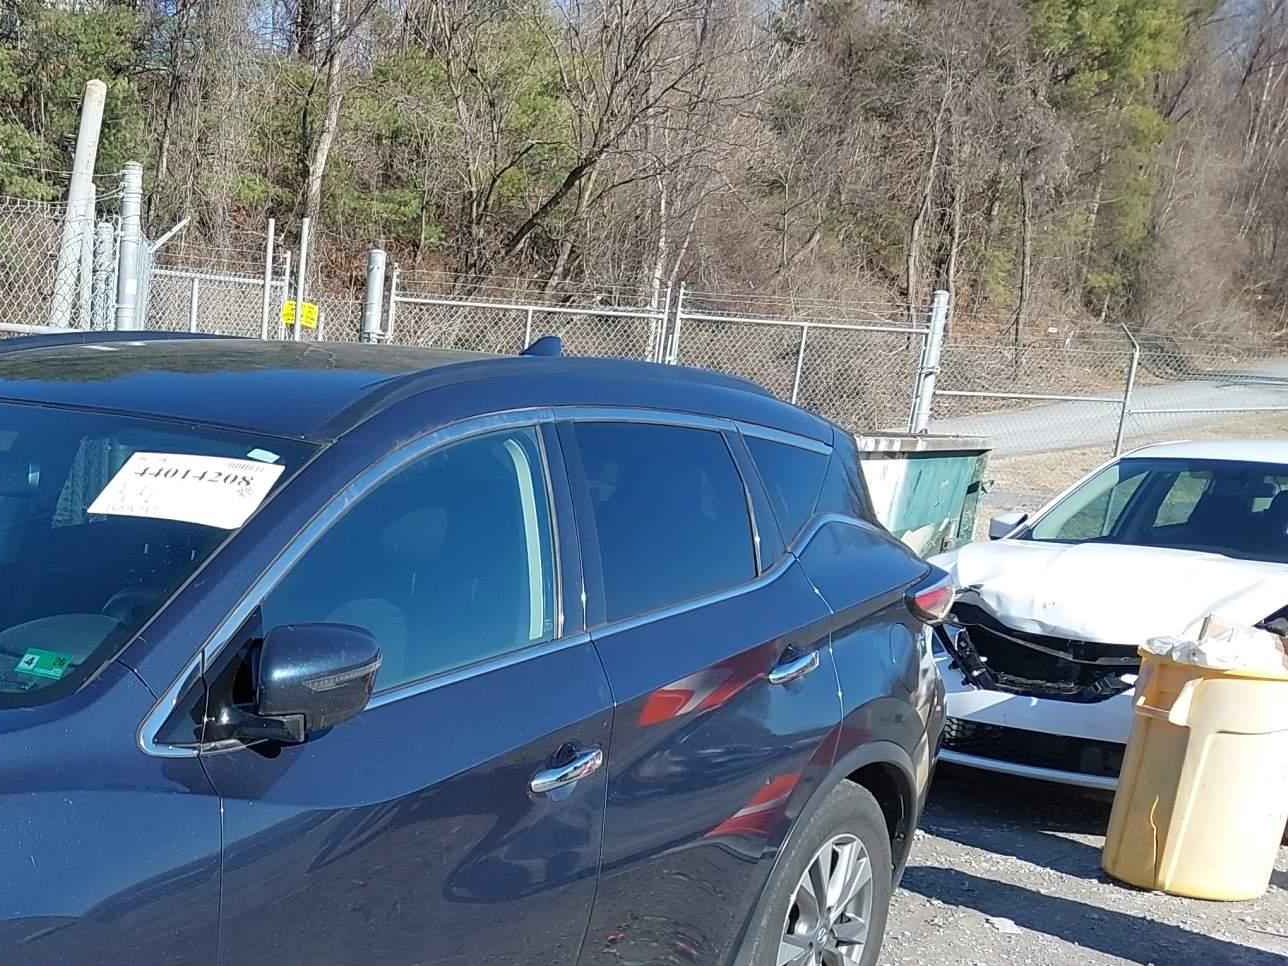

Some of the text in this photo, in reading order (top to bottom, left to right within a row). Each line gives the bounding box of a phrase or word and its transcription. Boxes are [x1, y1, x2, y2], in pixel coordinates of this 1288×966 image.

[135, 466, 254, 487] 44014208
[24, 657, 67, 667] 4 26
